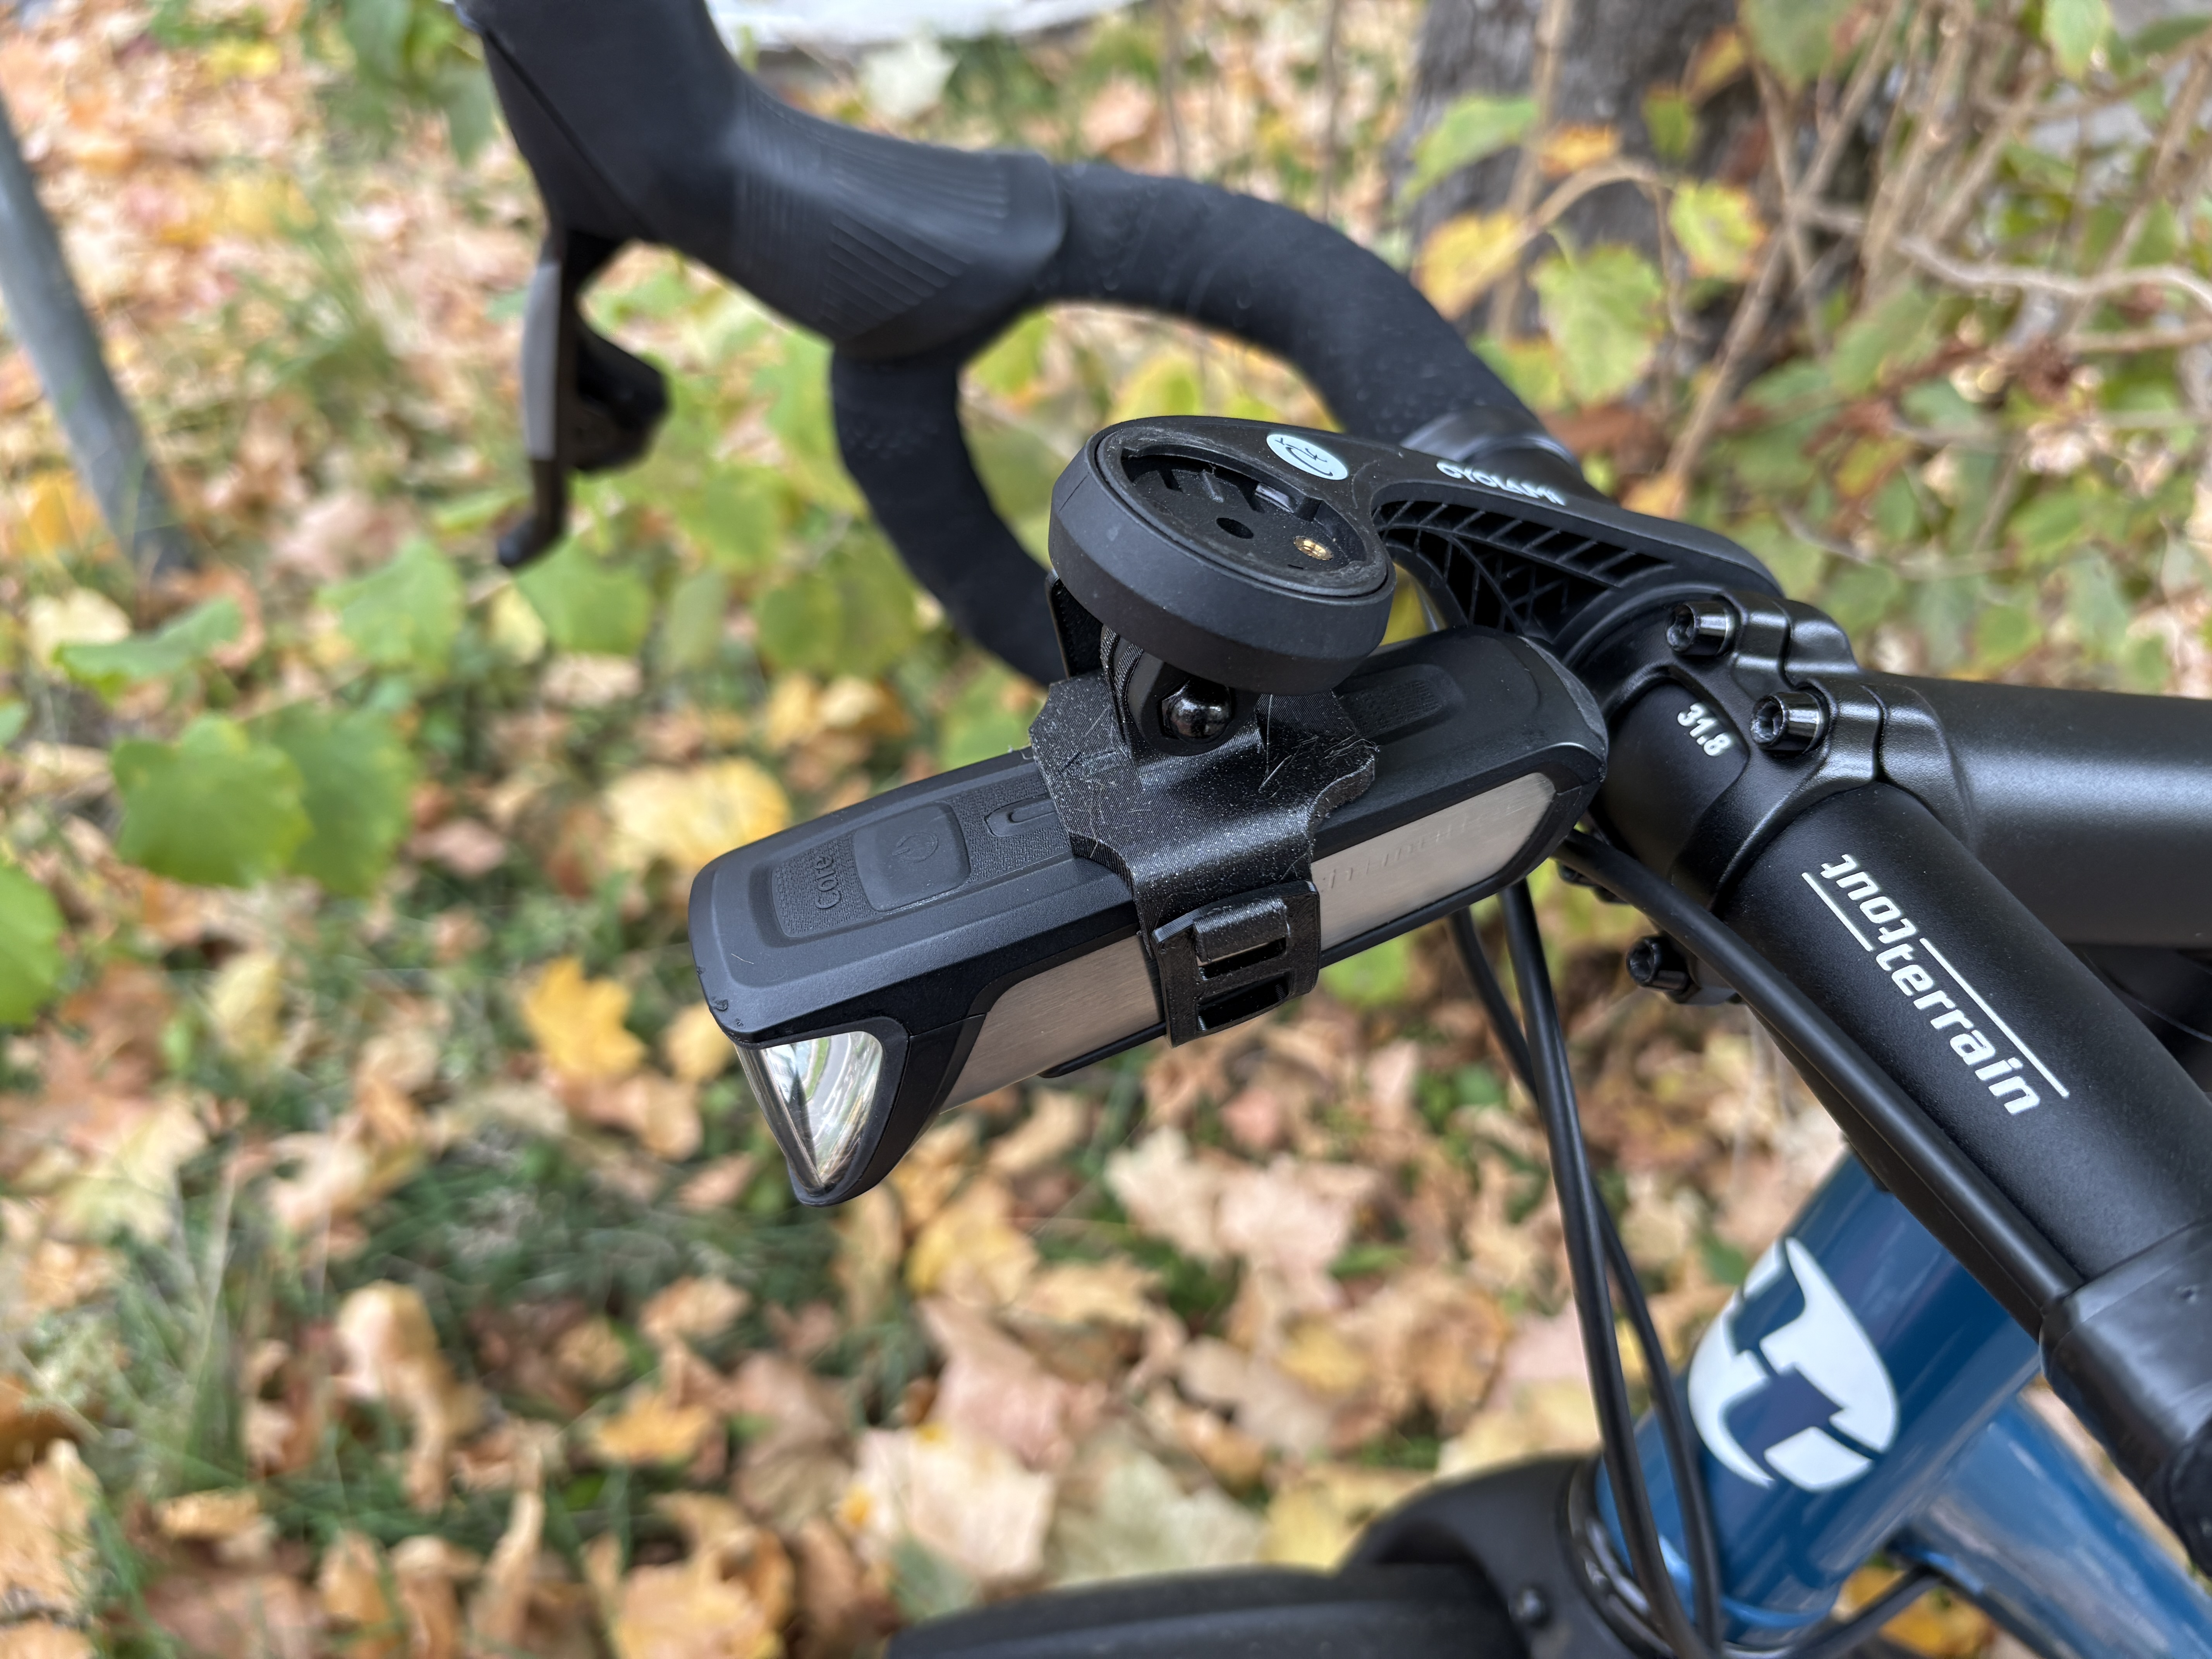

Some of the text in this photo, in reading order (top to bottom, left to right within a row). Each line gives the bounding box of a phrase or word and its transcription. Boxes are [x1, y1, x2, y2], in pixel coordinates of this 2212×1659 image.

[1677, 702, 1732, 757] 31.8
[812, 854, 843, 910] Core
[1875, 943, 2041, 1115] terrain
